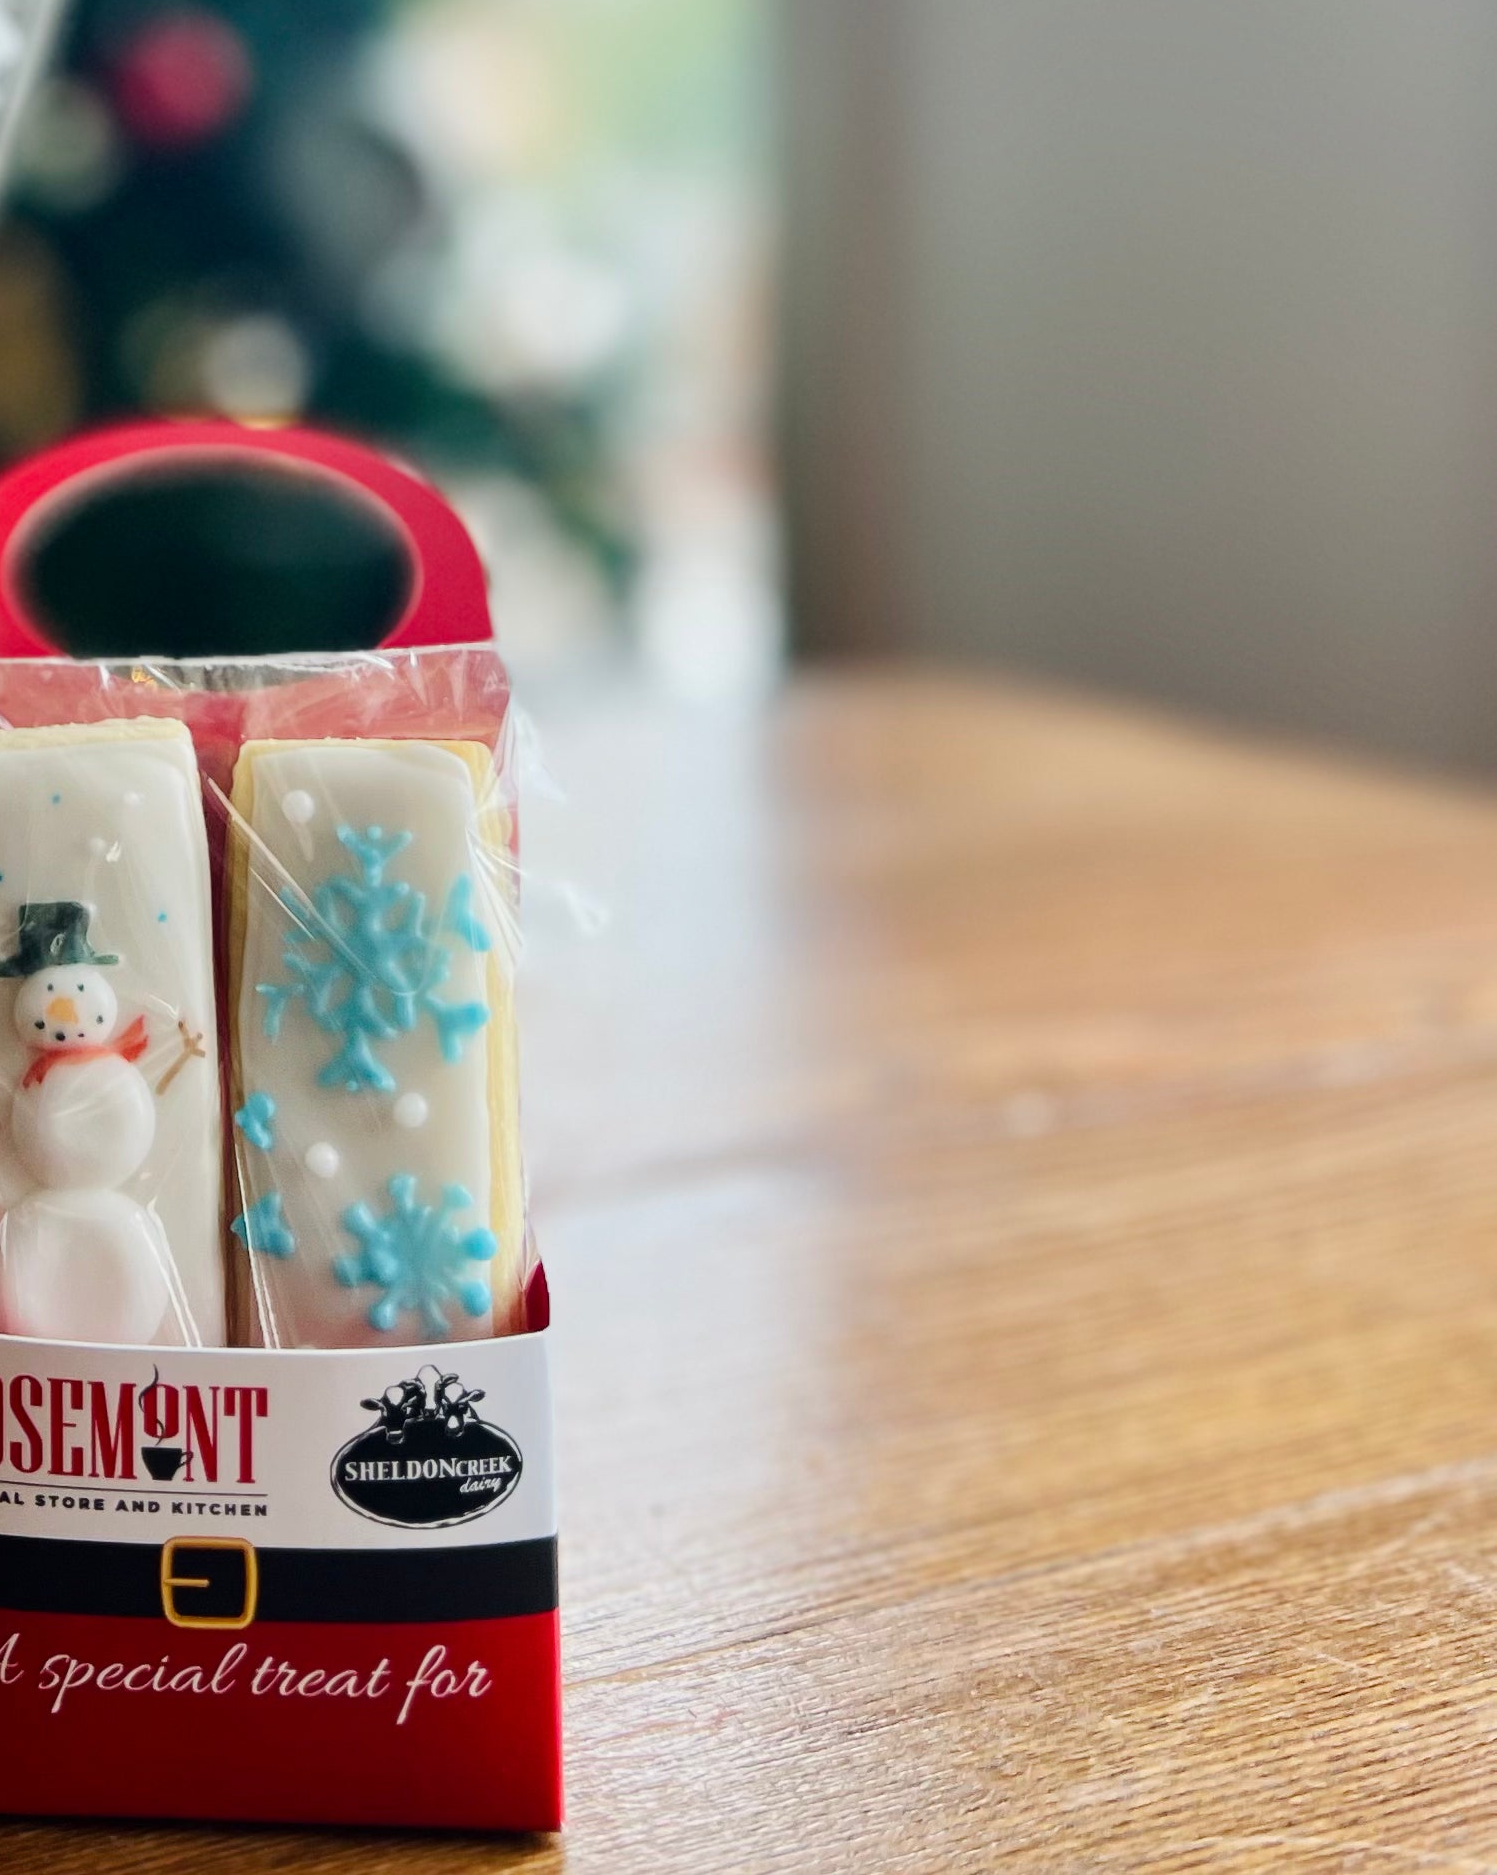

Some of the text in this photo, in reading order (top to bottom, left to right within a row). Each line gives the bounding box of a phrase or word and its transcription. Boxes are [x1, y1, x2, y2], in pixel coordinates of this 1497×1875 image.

[459, 1476, 502, 1494] dairy
[34, 1494, 105, 1511] STORE
[114, 1499, 161, 1513] AND
[171, 1501, 269, 1517] KITCHEN
[37, 1642, 248, 1714] special
[250, 1656, 392, 1699] treat
[395, 1644, 492, 1725] for
